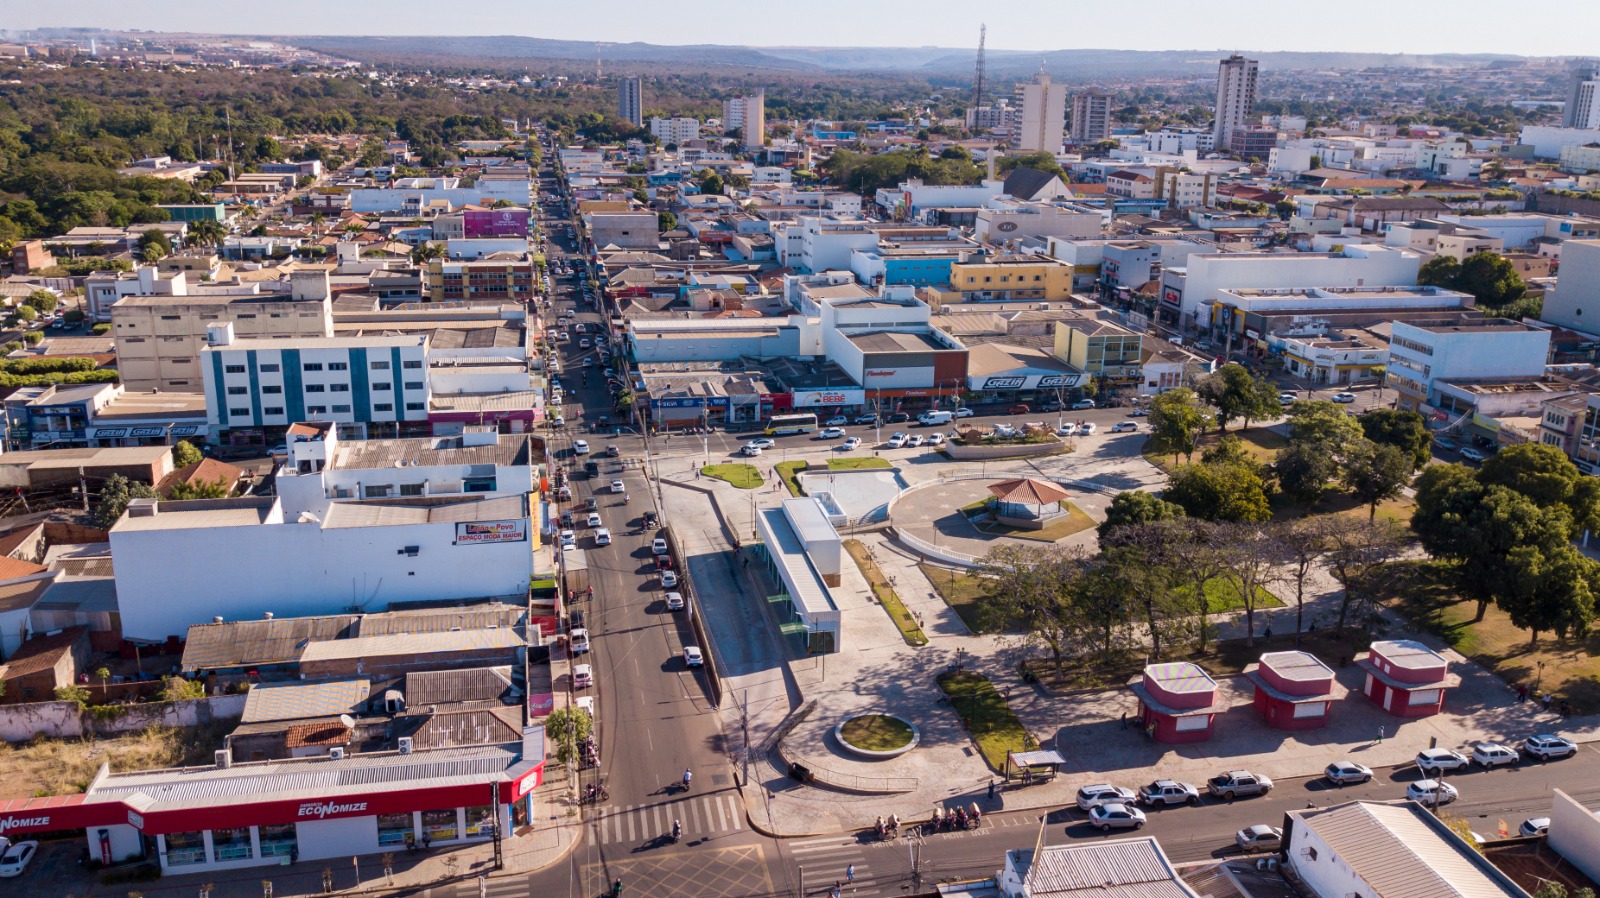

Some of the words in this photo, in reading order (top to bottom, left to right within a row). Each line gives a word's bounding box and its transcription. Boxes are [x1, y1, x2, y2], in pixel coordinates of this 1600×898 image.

[985, 377, 1025, 388] GAZIN
[1039, 376, 1080, 387] GAZIN
[823, 394, 845, 402] BEBÊ
[95, 428, 126, 438] GAZIN
[131, 428, 162, 437] GAZIN
[468, 525, 489, 533] Lojão
[298, 801, 368, 818] ECONOMIZE
[0, 816, 50, 833] NOMIZE
